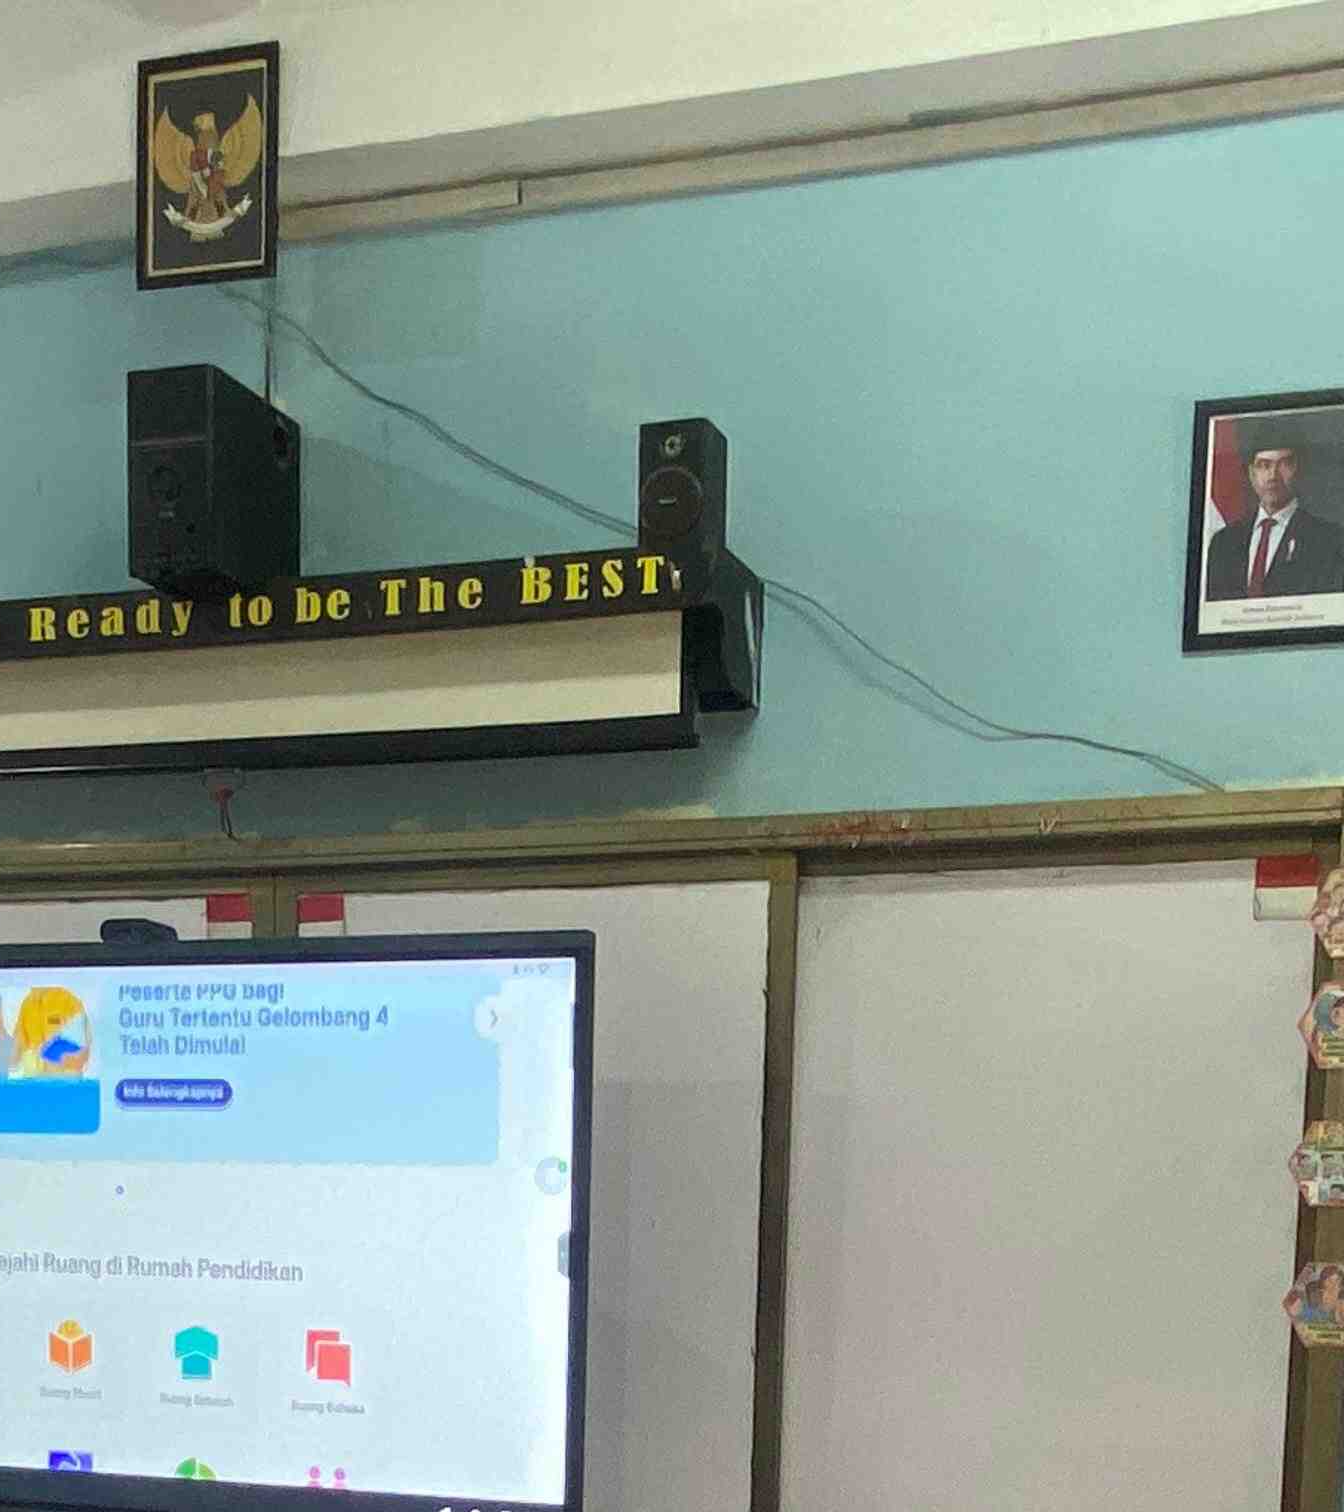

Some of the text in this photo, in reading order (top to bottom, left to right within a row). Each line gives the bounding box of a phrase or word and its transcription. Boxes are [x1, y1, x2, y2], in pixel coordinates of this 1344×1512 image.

[27, 599, 193, 643] Ready
[228, 591, 273, 628] to
[295, 585, 352, 624] be
[379, 574, 484, 616] The
[118, 1005, 389, 1031] Guru Tertentu Gelombang 4
[119, 1034, 170, 1055] Telah
[43, 1253, 102, 1279] Ruang
[106, 1256, 123, 1276] di
[127, 1257, 193, 1279] Rumah
[197, 1258, 304, 1282] Pendidikan
